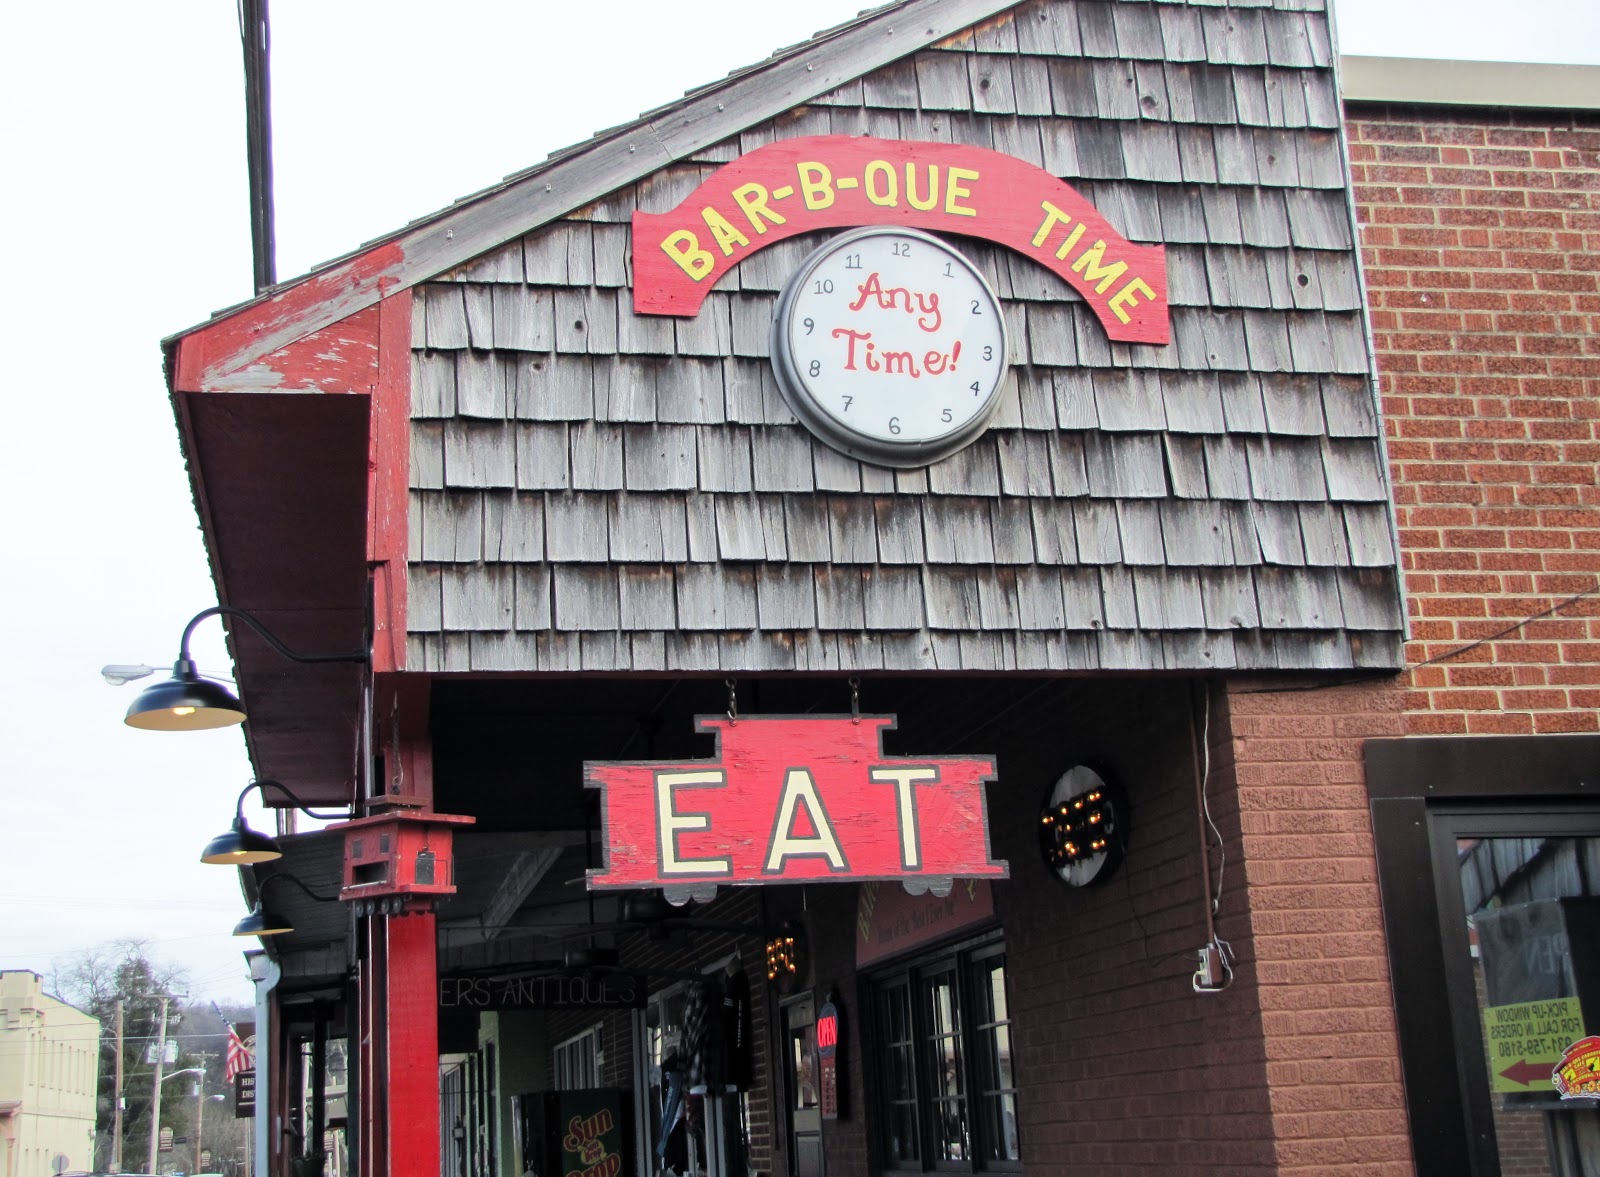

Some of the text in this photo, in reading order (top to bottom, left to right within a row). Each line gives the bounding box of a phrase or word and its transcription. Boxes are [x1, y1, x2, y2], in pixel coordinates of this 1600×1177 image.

[659, 159, 1157, 325] BAR-B-QUE TIME
[892, 242, 911, 258] 12
[845, 254, 863, 269] 11
[942, 262, 955, 278] 1
[813, 279, 834, 295] 10
[848, 272, 942, 332] Any
[970, 300, 982, 315] 2
[803, 318, 815, 335] 9
[831, 328, 962, 379] Time!
[982, 345, 993, 361] 3
[809, 360, 821, 377] 8
[970, 381, 980, 397] 4
[841, 395, 853, 412] 7
[940, 408, 953, 423] 5
[888, 417, 901, 435] 6
[655, 766, 939, 876] EAT
[501, 976, 636, 1005] ANTIQUES
[817, 1015, 837, 1048] OPEN
[563, 1108, 614, 1152] Sun
